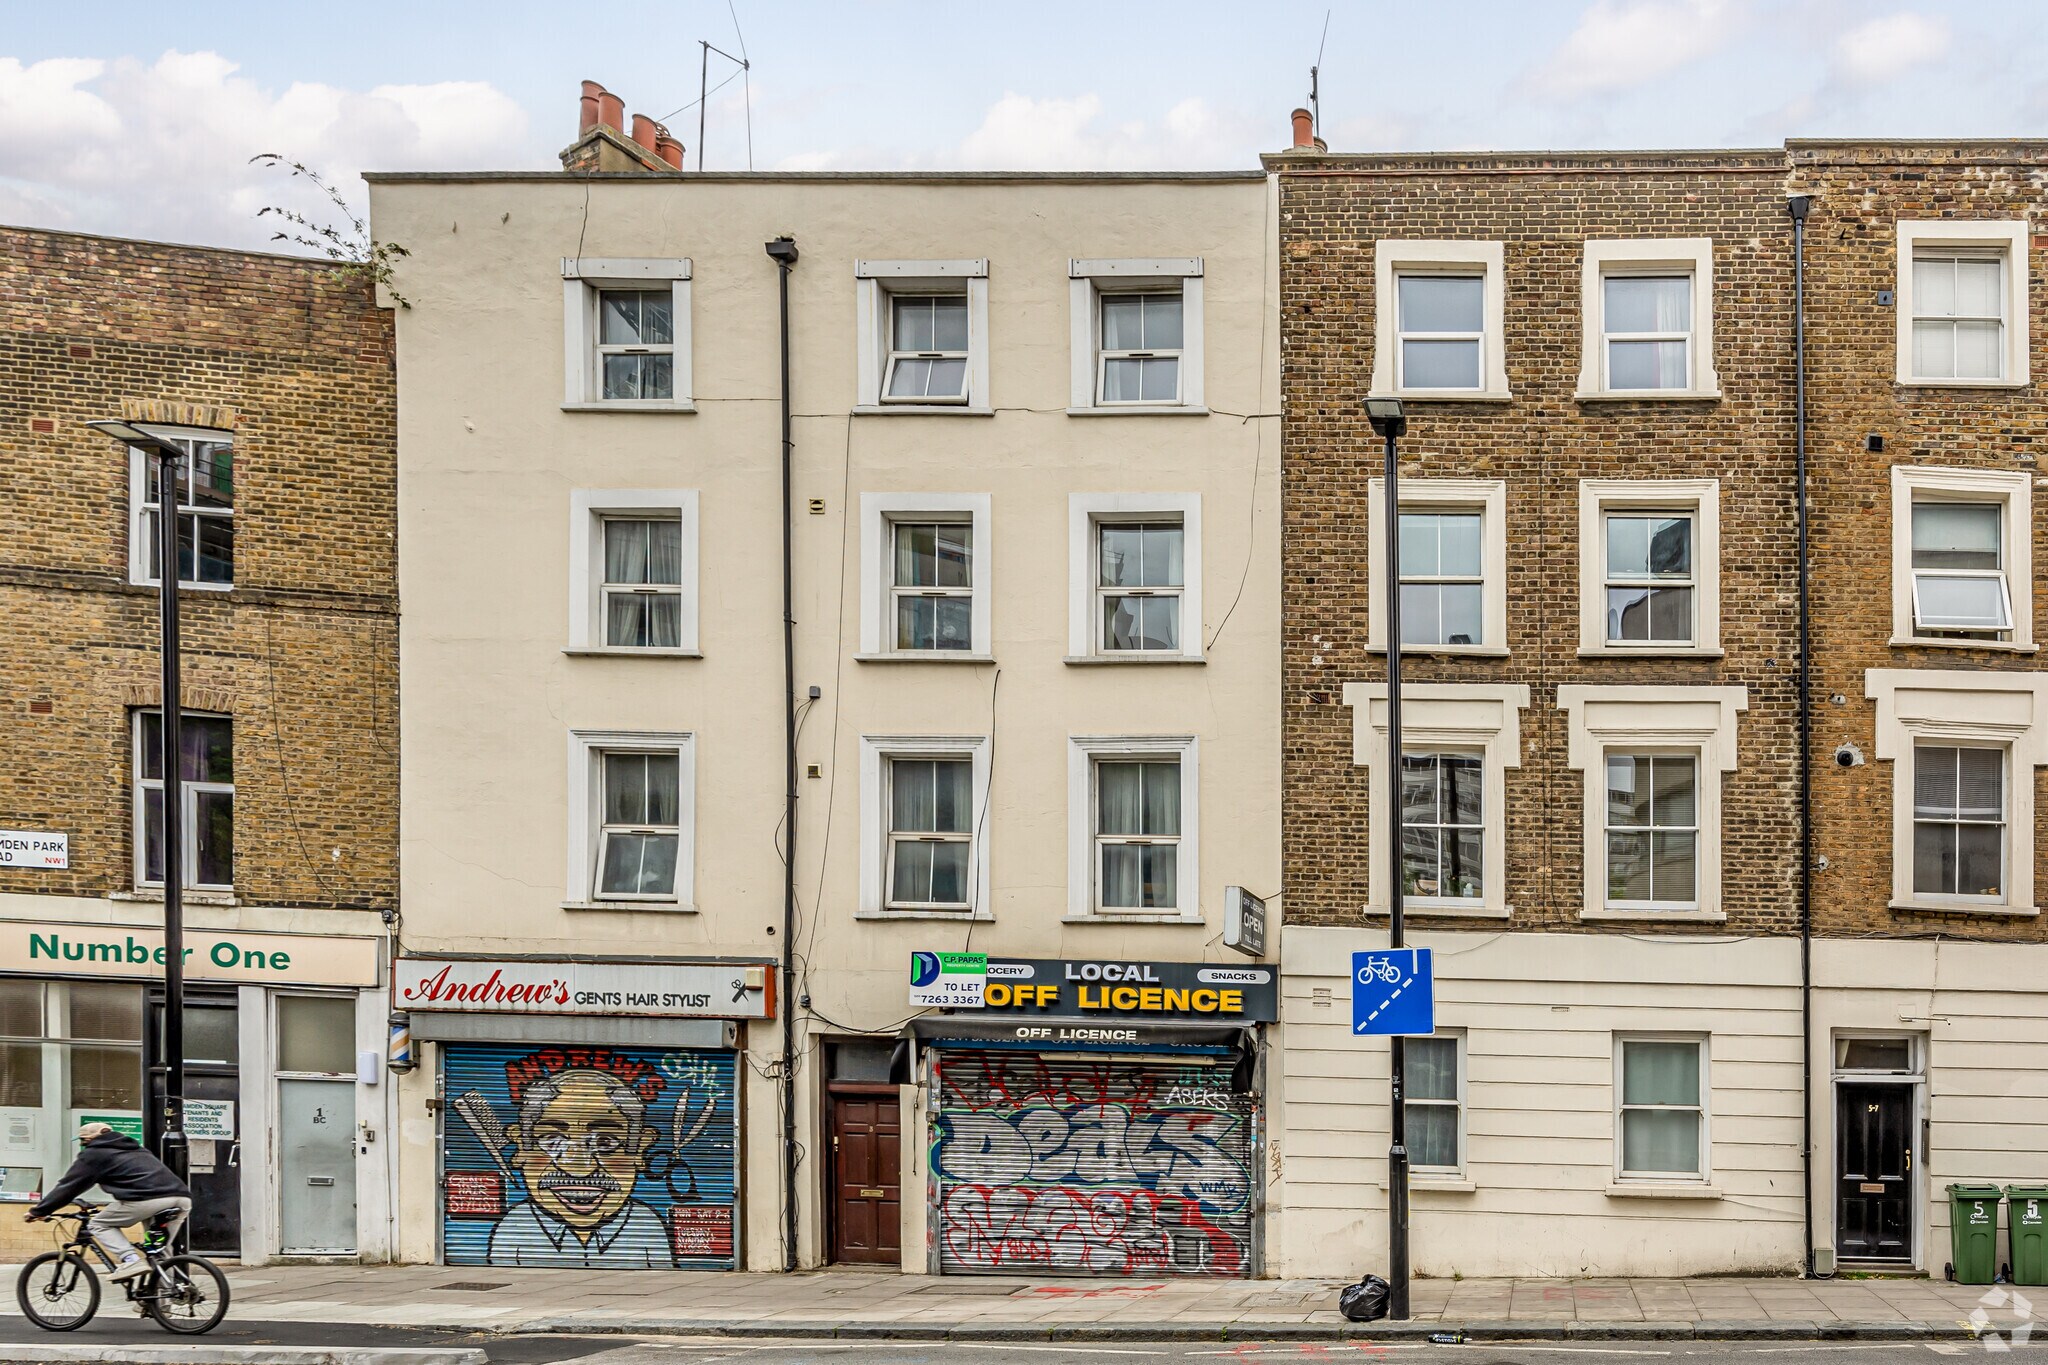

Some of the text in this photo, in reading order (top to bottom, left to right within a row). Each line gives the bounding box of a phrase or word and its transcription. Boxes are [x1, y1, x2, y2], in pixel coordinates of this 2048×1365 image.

[33, 841, 64, 852] PARK
[45, 856, 65, 865] NW1
[1243, 911, 1264, 935] OPEN
[30, 933, 291, 970] Number One
[958, 956, 984, 964] PAPAS
[987, 967, 1024, 975] OCERY
[1065, 963, 1160, 983] LOCAL
[1211, 972, 1257, 981] SNACKS
[404, 965, 711, 1007] Andrew's GENTS HAIR STYLIST
[944, 983, 980, 992] TO LET
[921, 995, 949, 1004] 7263
[953, 996, 980, 1004] 3367
[984, 983, 1244, 1013] OFF LICENCE
[1016, 1027, 1137, 1041] OFF LICENCE
[316, 1107, 323, 1117] 1
[1868, 1104, 1880, 1112] 5-7
[313, 1116, 327, 1124] BC
[1974, 1201, 1985, 1216] 5
[2027, 1199, 2039, 1218] 5
